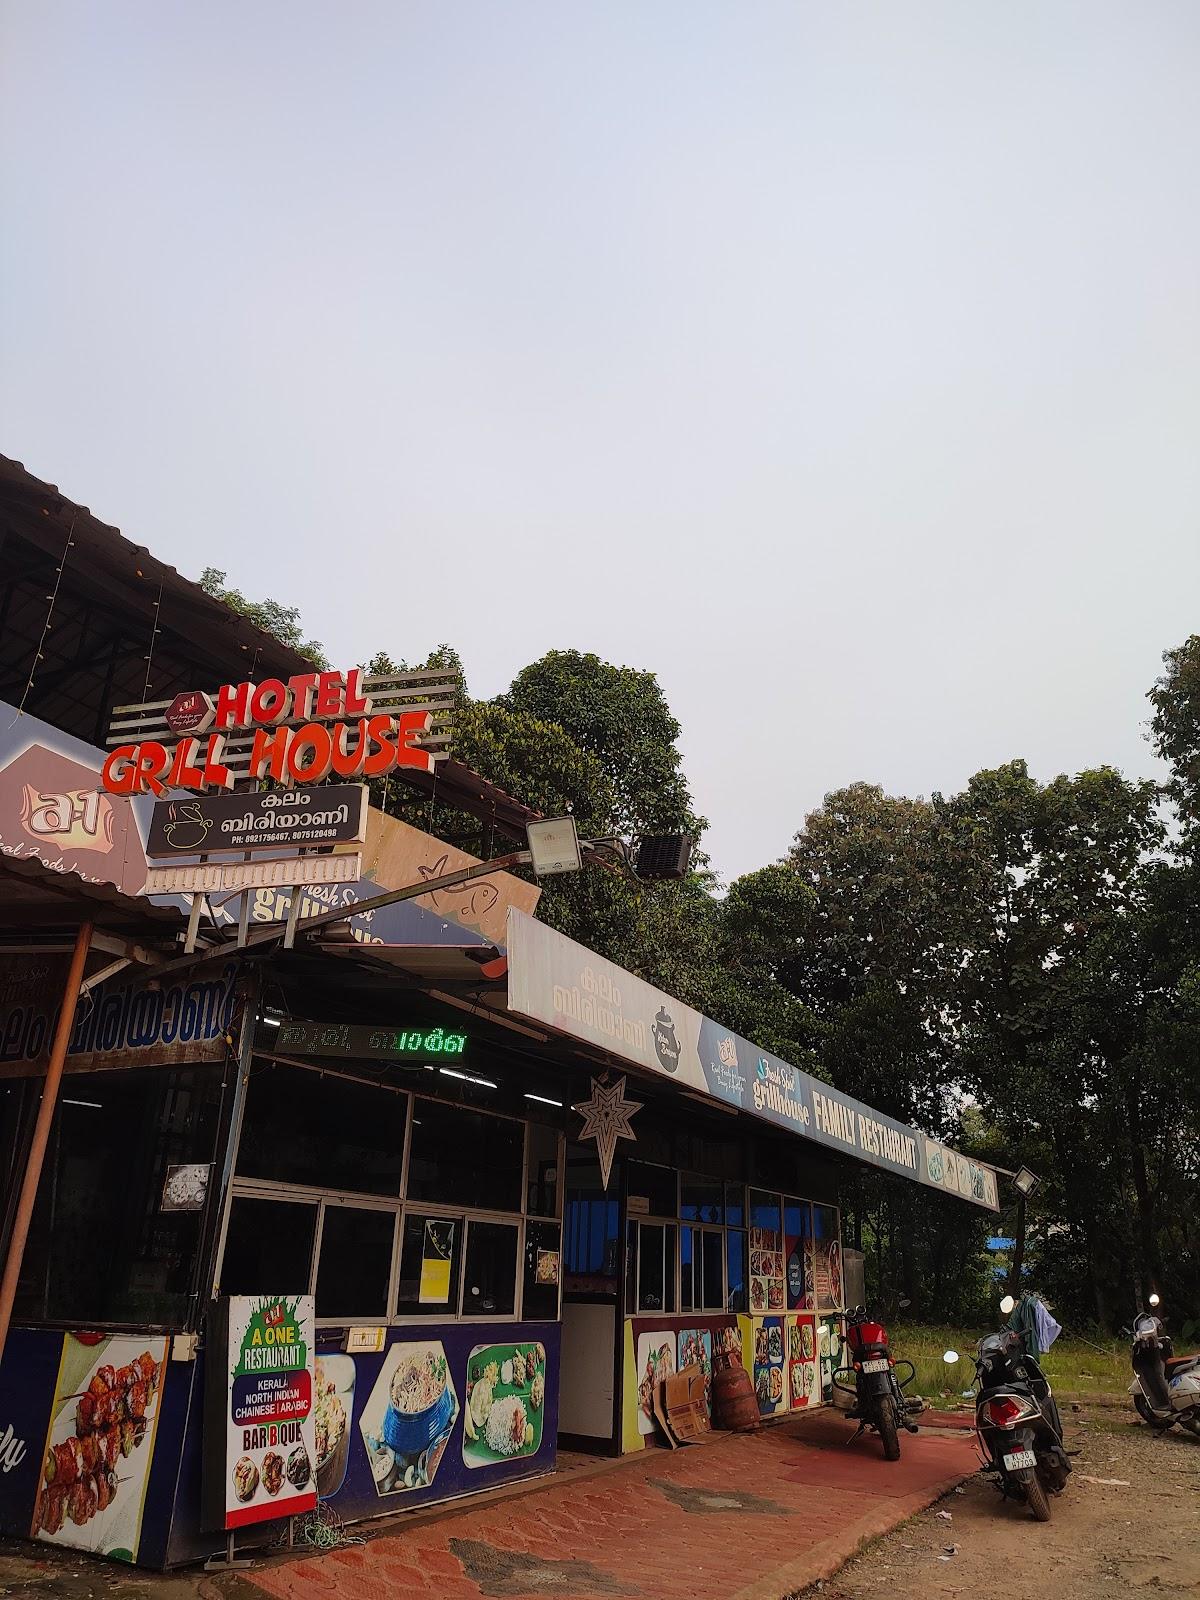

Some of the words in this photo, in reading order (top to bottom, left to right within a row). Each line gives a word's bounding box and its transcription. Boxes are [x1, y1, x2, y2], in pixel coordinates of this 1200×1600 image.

[215, 669, 373, 730] HOTEL
[102, 733, 234, 800] GRILL
[249, 711, 434, 786] HOUSE
[261, 792, 311, 809] കലം
[220, 804, 349, 833] ബിരിയാണി
[231, 835, 244, 844] PH:
[753, 1079, 810, 1126] grillhouse
[812, 1090, 856, 1146] FAMILY
[858, 1113, 917, 1170] RESTAURANT
[252, 1328, 263, 1346] A
[264, 1326, 295, 1345] ONE
[244, 1345, 301, 1370] RESTAURANT
[257, 1378, 289, 1391] KERALA
[245, 1391, 273, 1405] NORTH
[274, 1388, 300, 1401] INDIAN
[235, 1404, 276, 1419] CHAINESE
[280, 1399, 309, 1413] ARABIC
